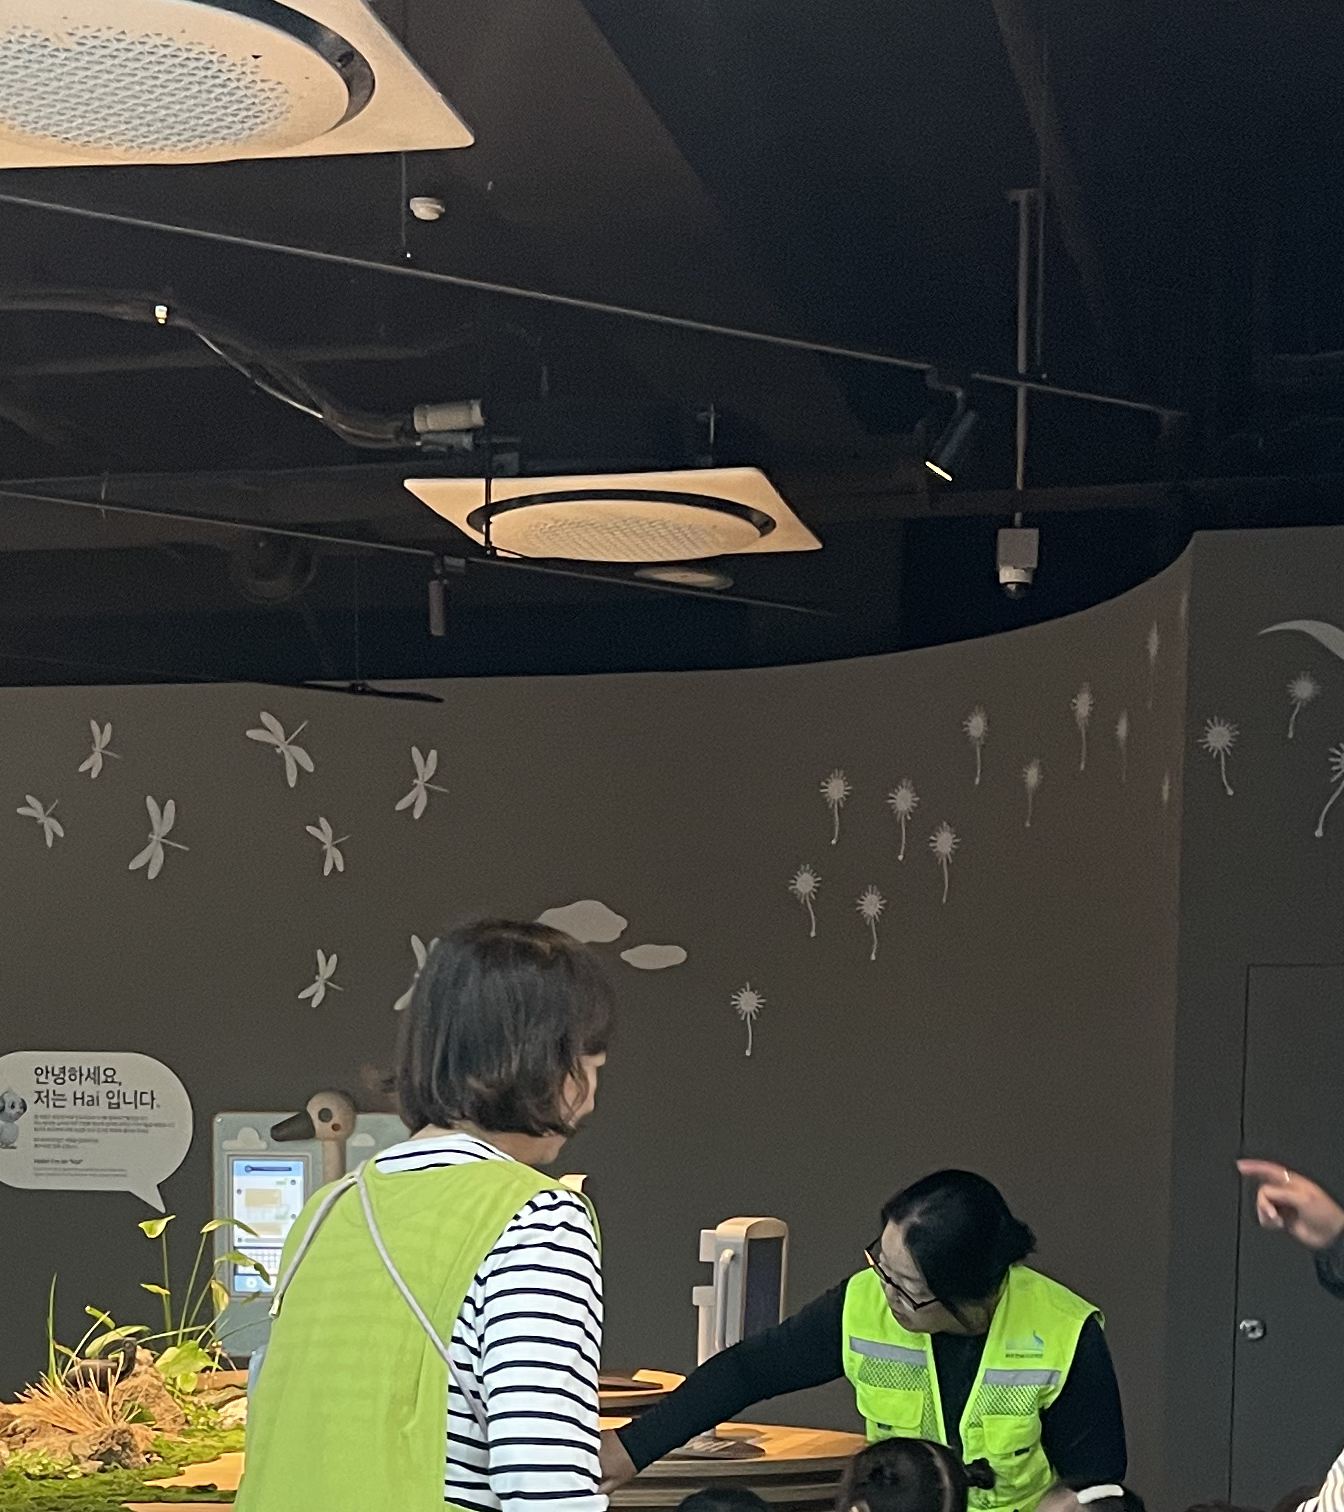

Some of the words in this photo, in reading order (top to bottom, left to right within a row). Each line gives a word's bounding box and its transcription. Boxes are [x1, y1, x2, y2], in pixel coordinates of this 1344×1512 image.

[34, 1065, 123, 1087] 안녕하세요,
[34, 1089, 68, 1109] 저는
[72, 1090, 100, 1107] Hai
[105, 1089, 161, 1110] 입니다.
